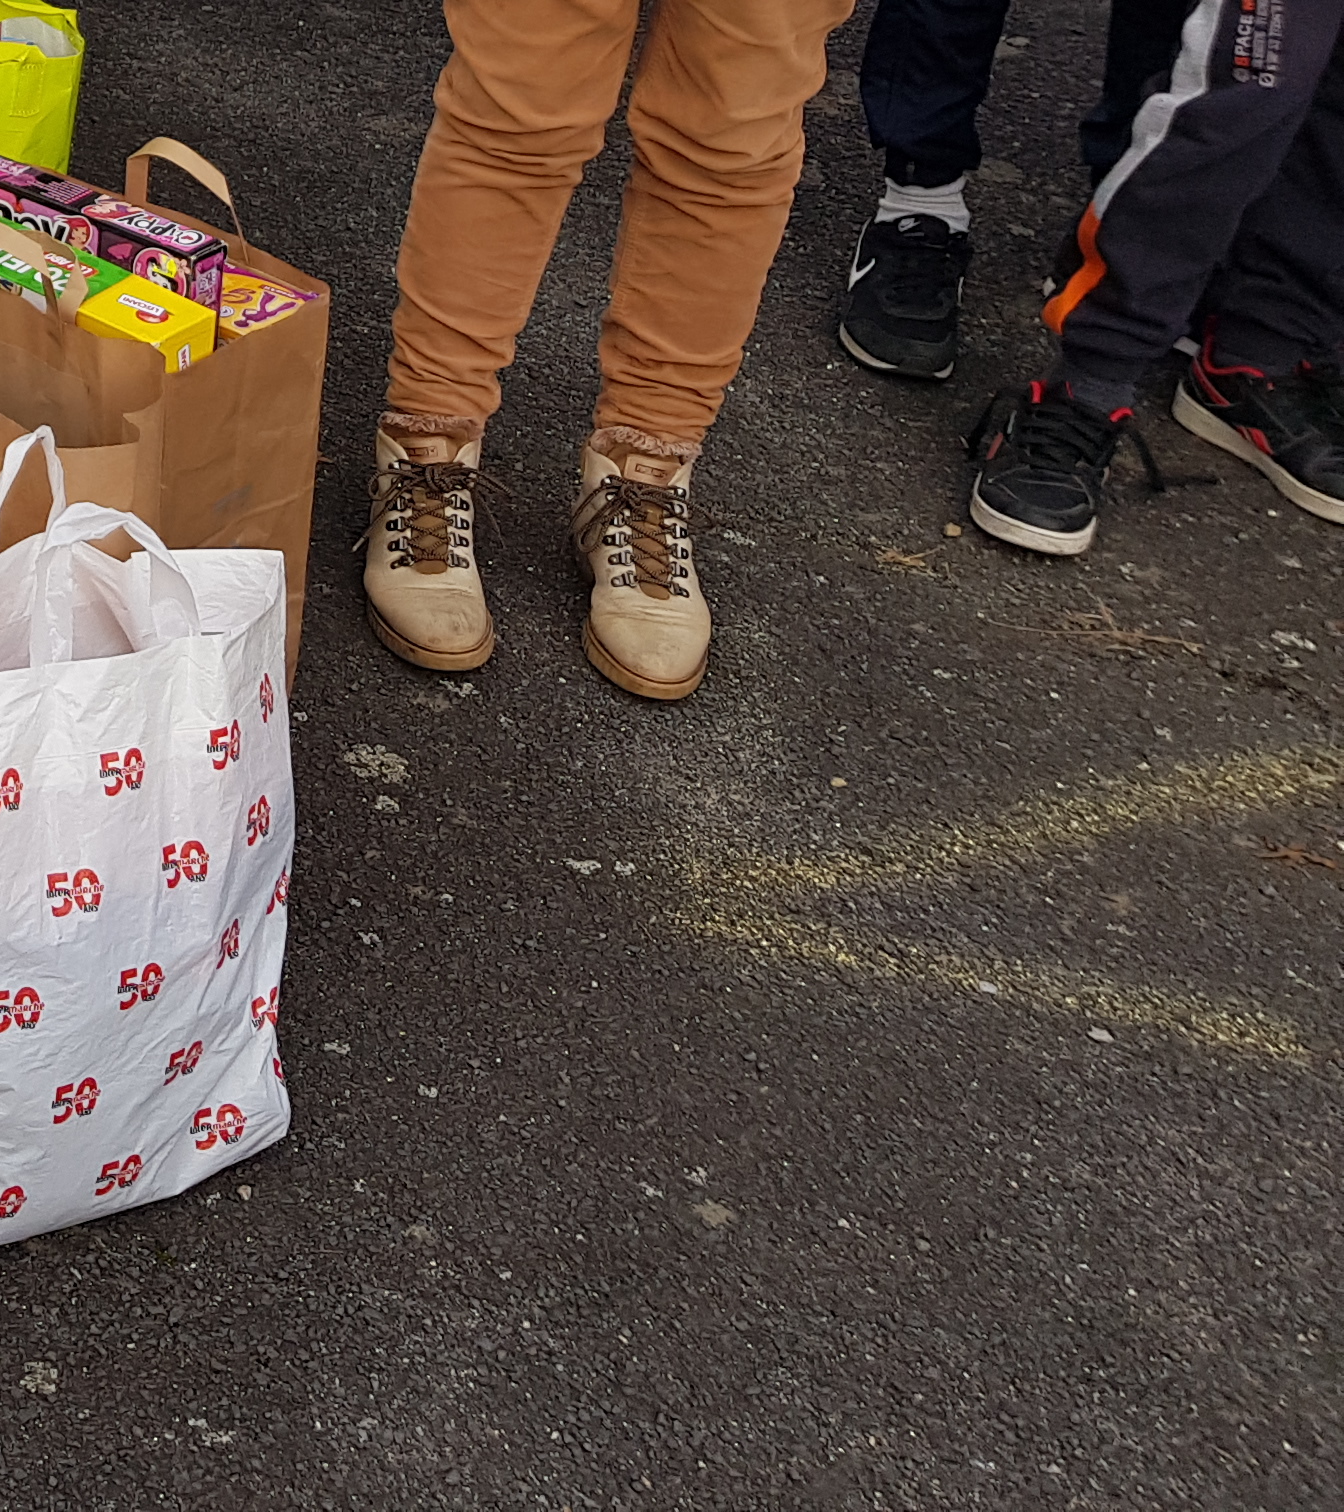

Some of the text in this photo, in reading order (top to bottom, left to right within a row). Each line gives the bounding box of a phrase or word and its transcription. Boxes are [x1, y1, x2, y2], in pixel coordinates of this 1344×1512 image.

[210, 719, 240, 770] 50
[100, 748, 144, 796] 50
[162, 840, 208, 889] 50
[47, 868, 102, 917] 50
[120, 962, 163, 1011] 50
[53, 1077, 98, 1124] 50
[193, 1104, 246, 1150] 50
[95, 1154, 142, 1195] 50
